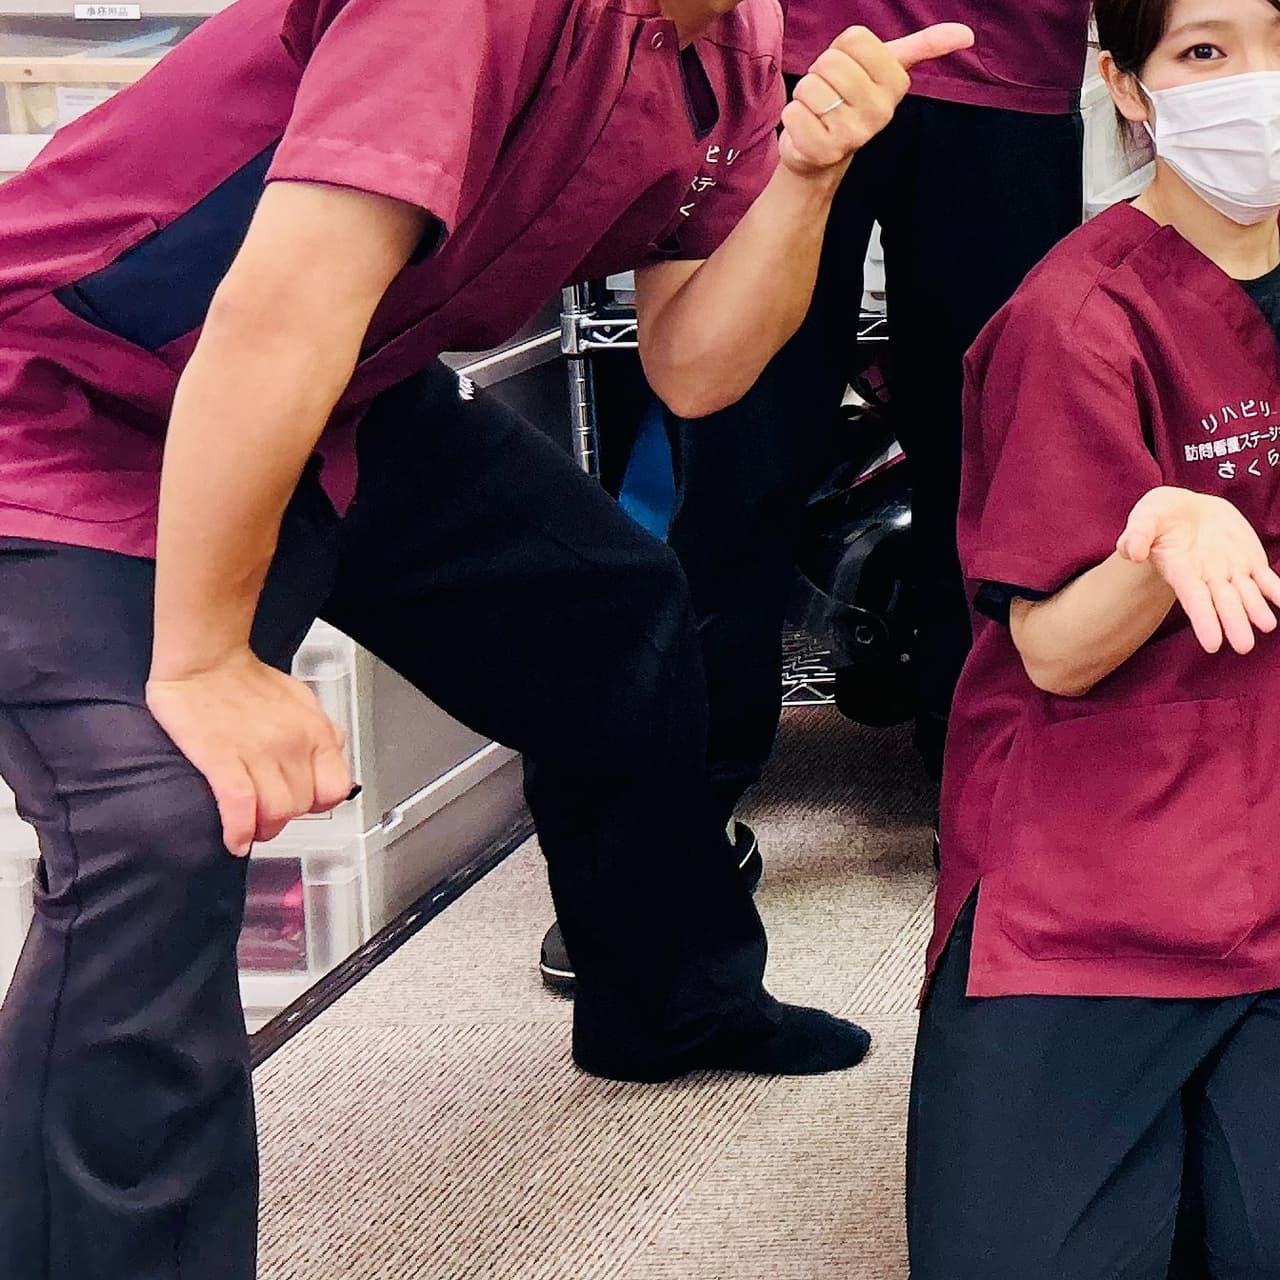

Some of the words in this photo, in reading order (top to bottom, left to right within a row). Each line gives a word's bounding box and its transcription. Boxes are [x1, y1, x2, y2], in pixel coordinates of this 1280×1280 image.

[1201, 400, 1270, 434] リハビリ
[1218, 448, 1280, 479] さくら
